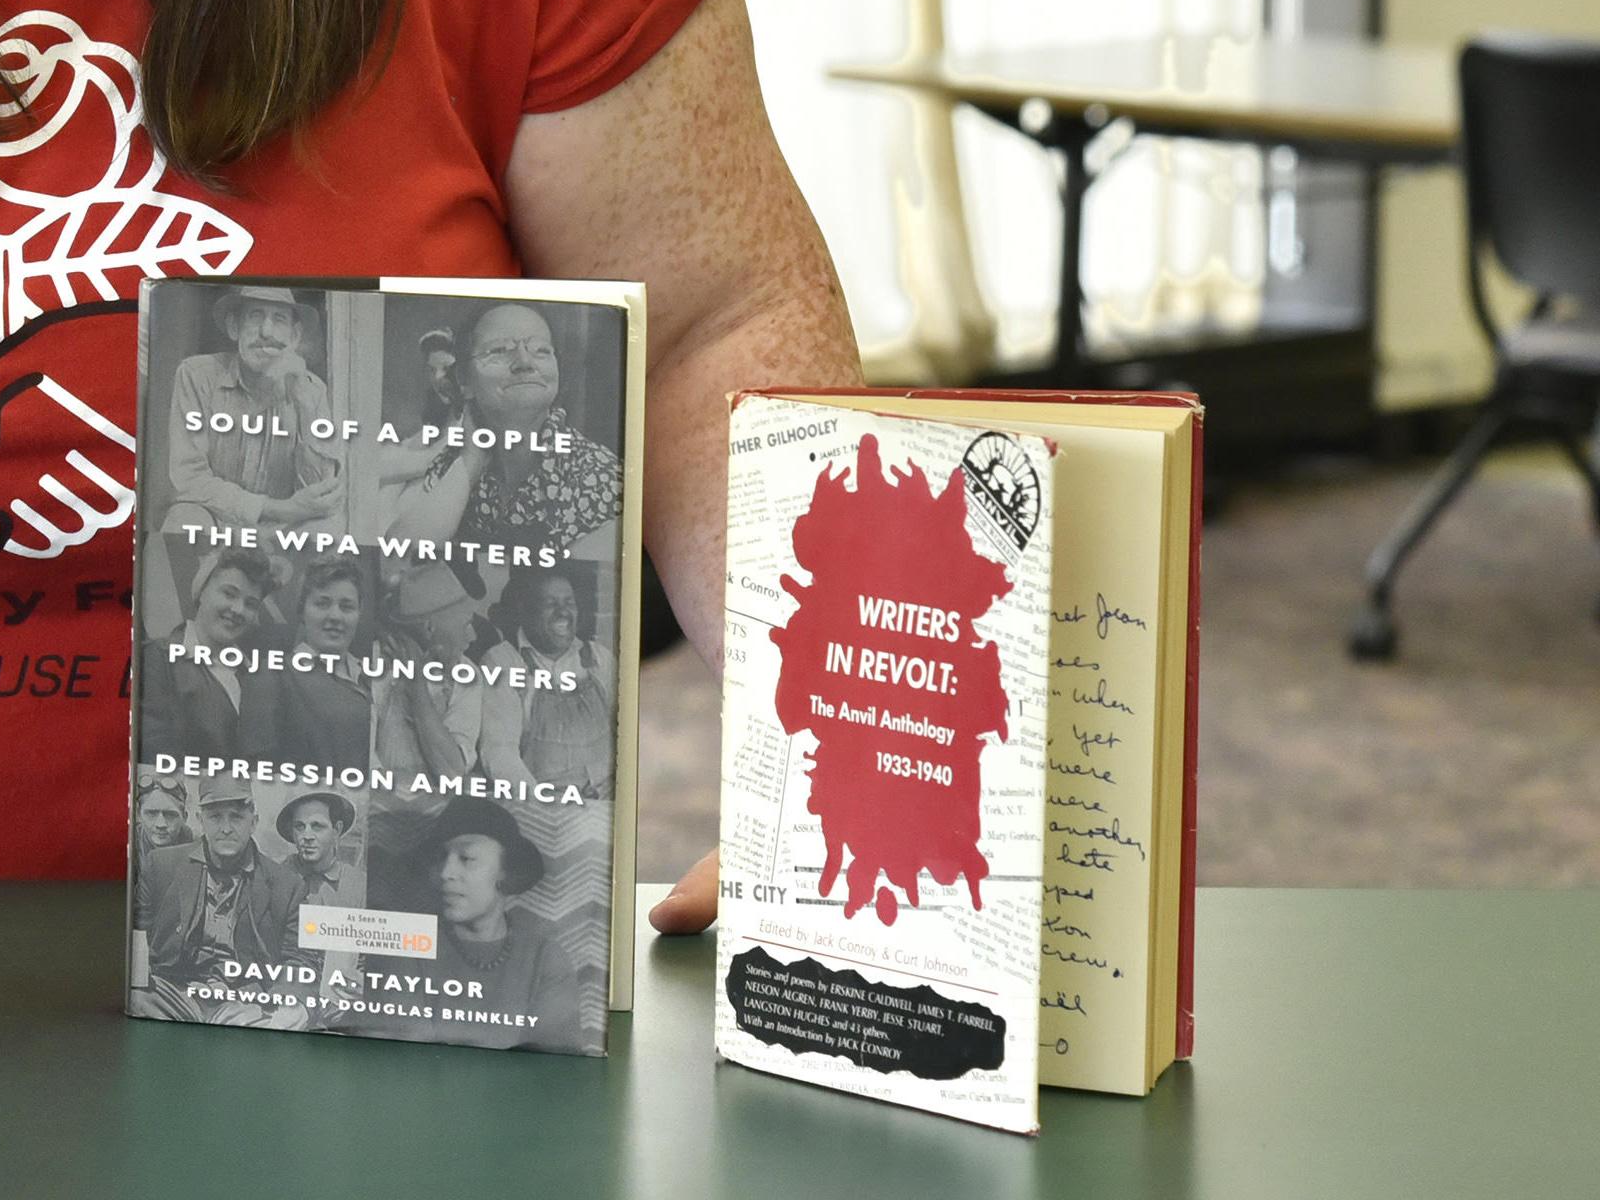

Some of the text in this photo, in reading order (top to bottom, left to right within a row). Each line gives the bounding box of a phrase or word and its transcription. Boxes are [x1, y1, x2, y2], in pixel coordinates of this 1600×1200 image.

[185, 412, 573, 454] SOUL OF A PEOPLE
[767, 418, 838, 448] GILHOOLEY
[975, 491, 1020, 545] ANVIL
[182, 525, 258, 548] THE
[276, 529, 360, 555] WPA
[741, 576, 781, 602] Conroy
[859, 595, 960, 642] WRITERS
[169, 645, 577, 691] PROJECT UNCOVERS
[826, 642, 853, 674] IN
[859, 648, 958, 696] REVOLT:
[810, 695, 956, 746] The Anvil Anthology
[156, 754, 584, 805] DEPRESSION AMERICA
[877, 752, 952, 787] 1933-1940
[753, 883, 788, 905] CITY
[319, 922, 401, 942] Smithsonian
[347, 913, 356, 922] As
[358, 914, 376, 923] Seen
[355, 932, 433, 952] CHANNEL HD
[760, 919, 792, 938] Edited
[796, 927, 808, 942] by
[814, 932, 833, 948] Jack
[838, 936, 876, 961] Conroy
[882, 947, 890, 960] &
[895, 950, 918, 967] Curt
[924, 955, 968, 977] Johnson
[224, 960, 484, 999] DAVID A. TAYLOR
[746, 963, 771, 979] Stories
[773, 971, 789, 985] and
[790, 976, 815, 990] poems
[818, 980, 829, 994] by
[830, 983, 866, 1000] ERSKINE
[917, 1003, 945, 1019] JAMES
[945, 1008, 955, 1020] T.
[187, 987, 539, 1028] FOREWORD BY DOUGLAS BRINKLEY
[744, 997, 791, 1017] LANGSTON
[793, 1009, 830, 1026] HUGHES
[832, 1020, 848, 1031] and
[745, 980, 780, 997] NELSON
[820, 998, 849, 1014] FRANK
[883, 1012, 905, 1027] JESSE
[743, 1014, 902, 1060] With an Introduction by JACK CONROY
